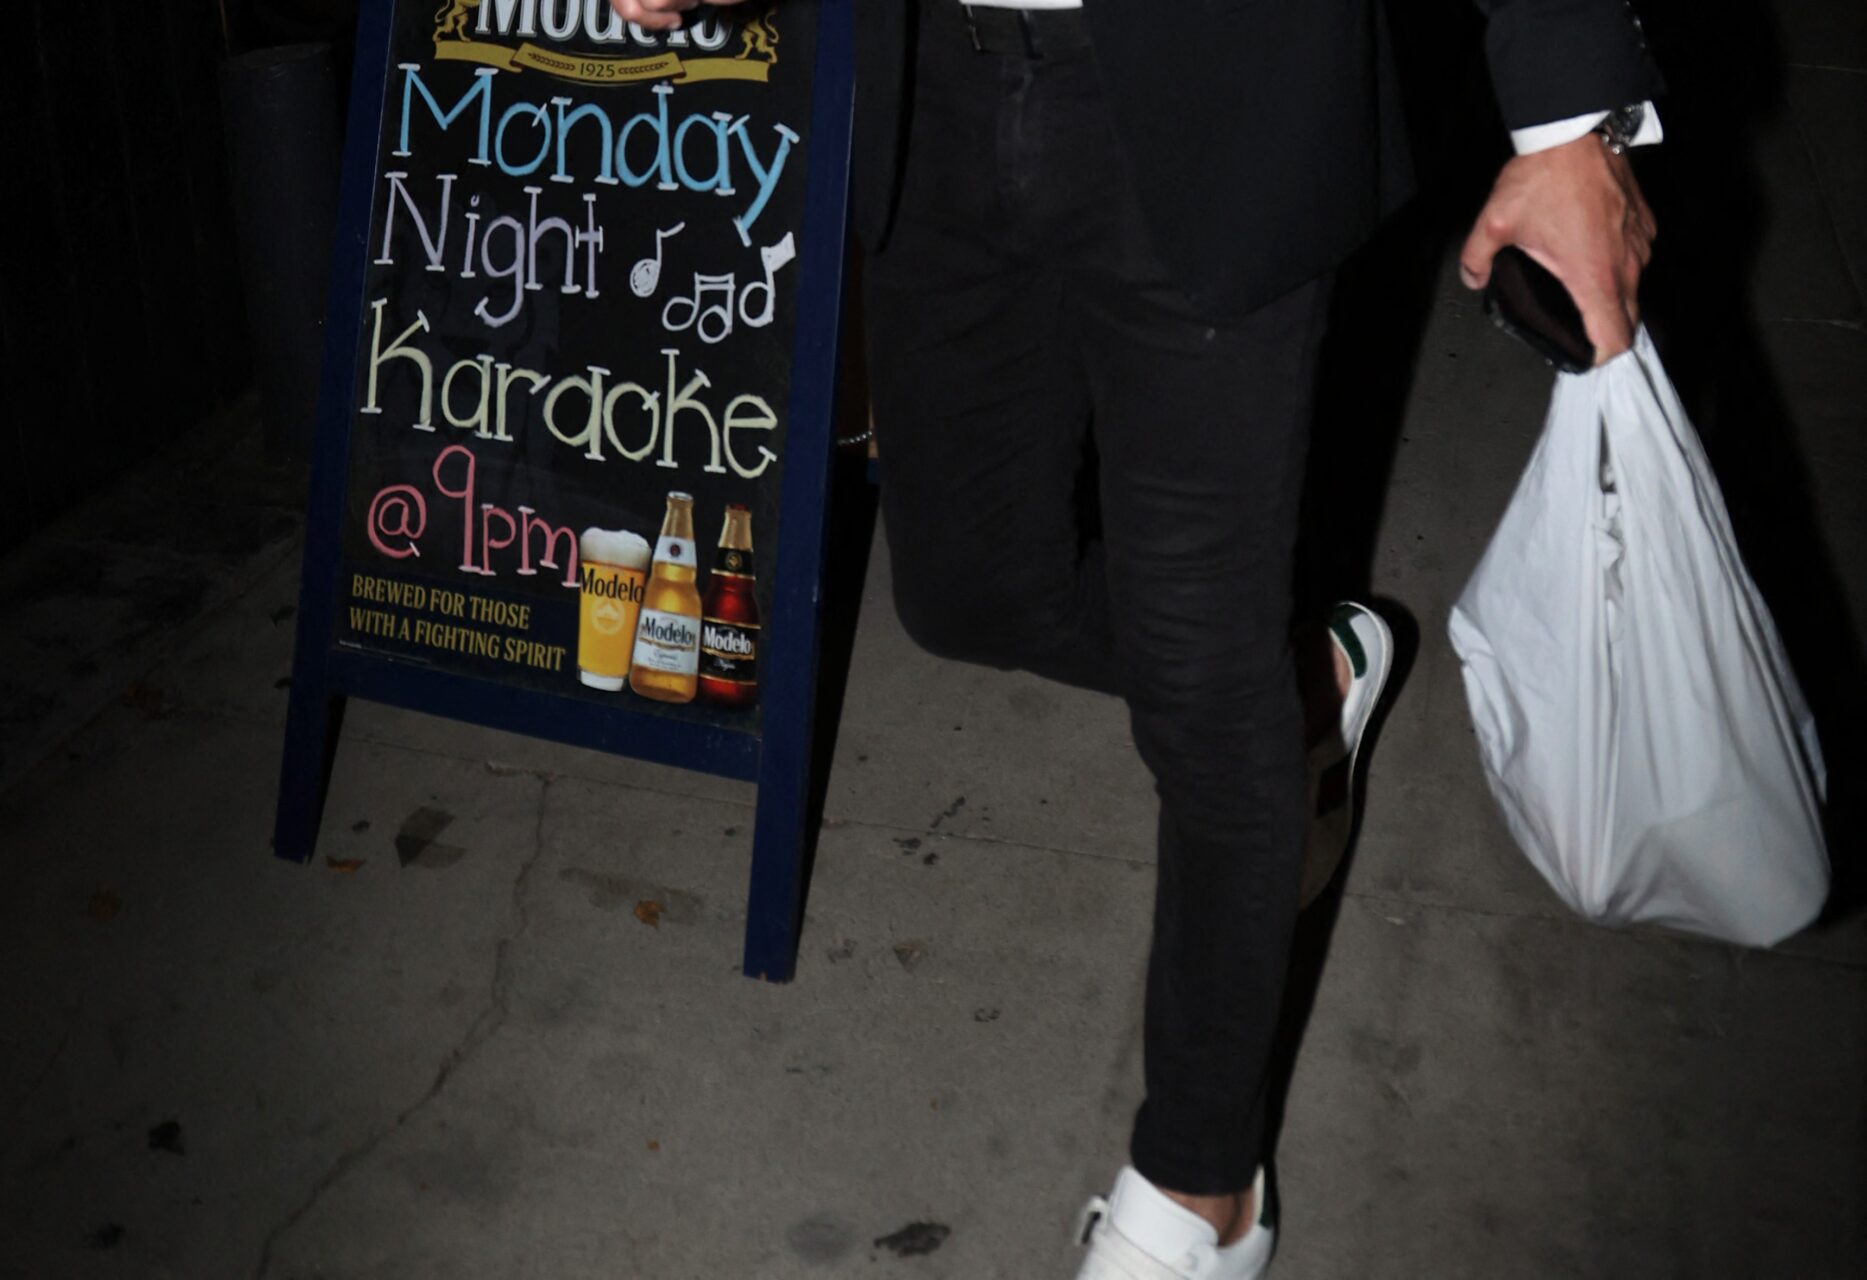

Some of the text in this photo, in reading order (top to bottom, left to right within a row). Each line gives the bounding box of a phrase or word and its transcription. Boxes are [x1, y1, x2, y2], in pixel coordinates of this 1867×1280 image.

[579, 62, 616, 78] 1925
[392, 62, 800, 247] Monday
[373, 171, 604, 328] Night
[360, 297, 779, 479] Karaoke
[367, 444, 581, 588] @ 9pm
[351, 573, 532, 630] BREWED FOR THOSE
[579, 566, 644, 604] Modelo
[349, 606, 395, 638] WITH
[397, 617, 411, 642] A
[413, 620, 501, 659] FIGHTING
[503, 637, 567, 672] SPIRIT
[645, 617, 692, 645] Modelo
[703, 625, 752, 655] Modelo
